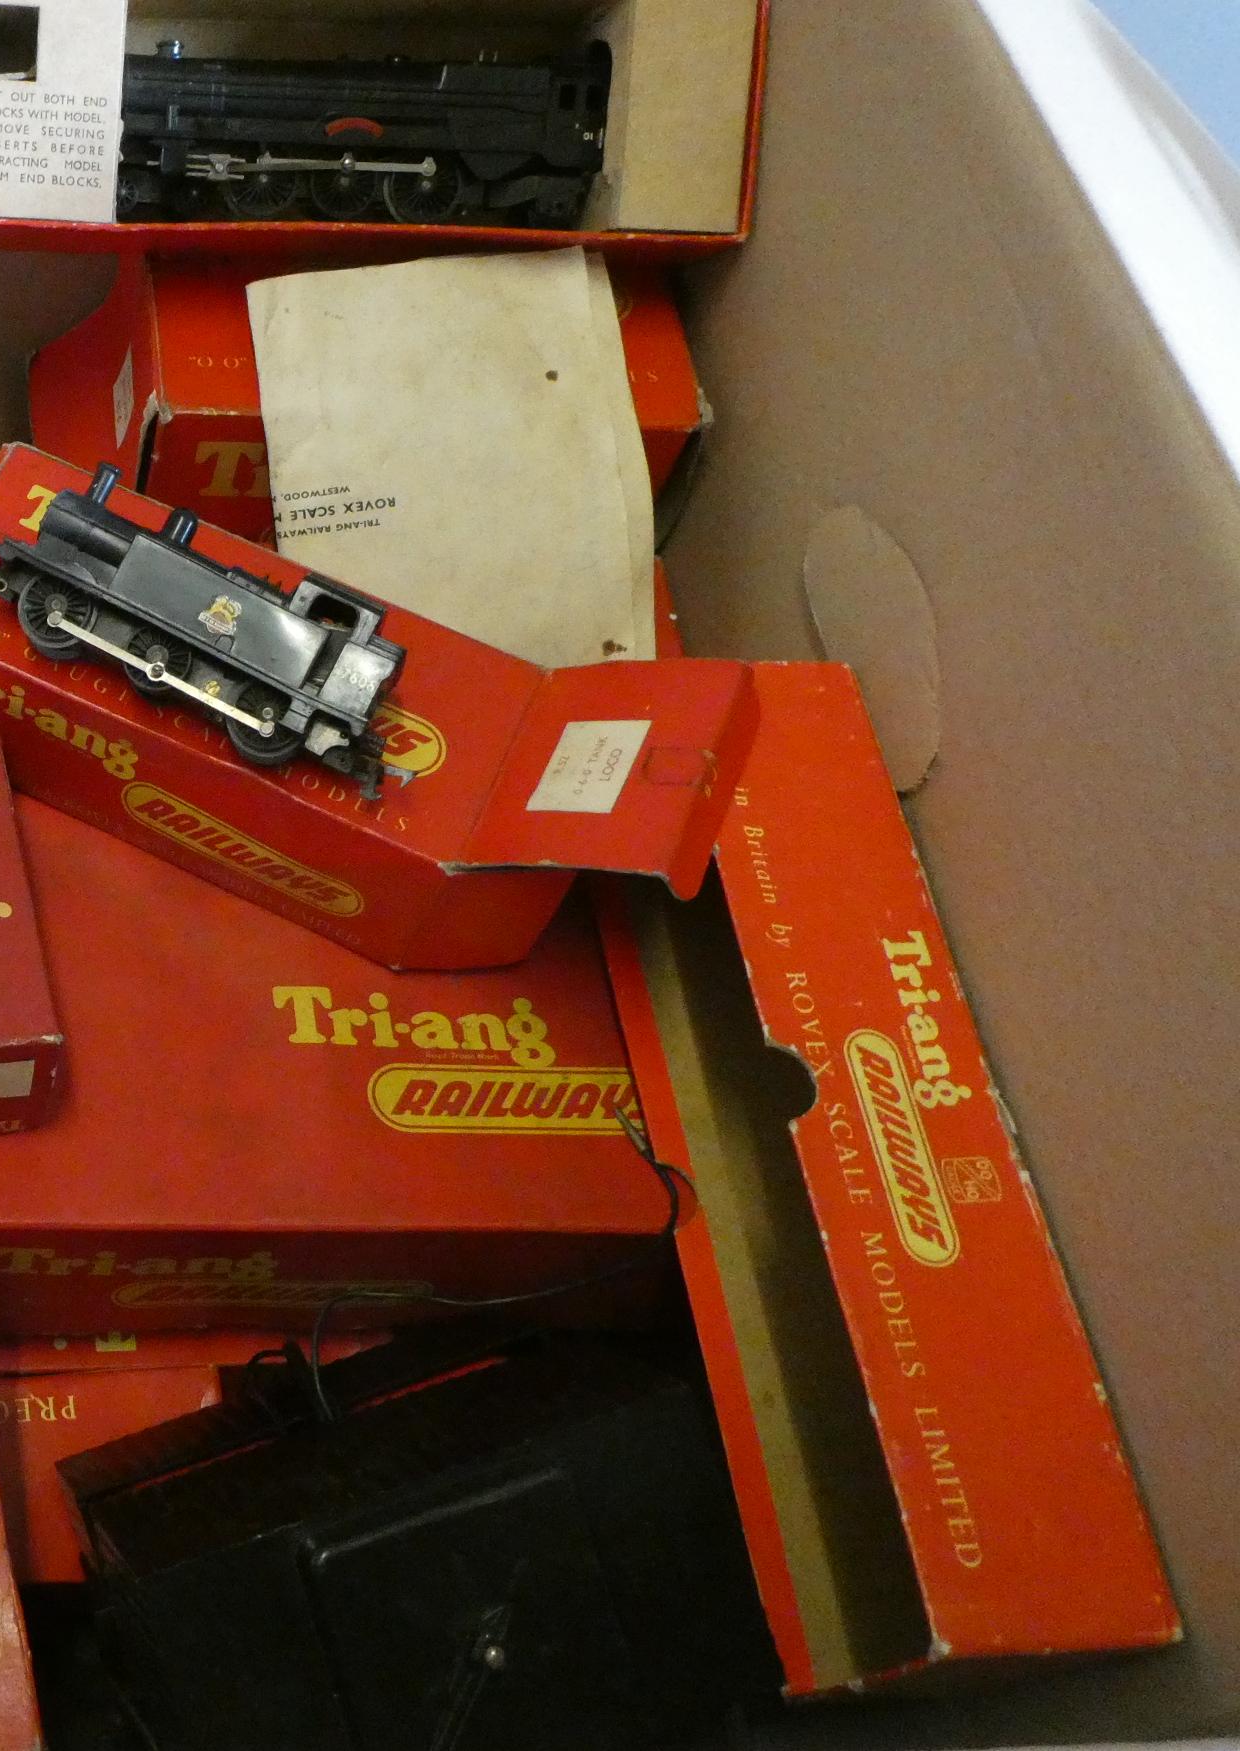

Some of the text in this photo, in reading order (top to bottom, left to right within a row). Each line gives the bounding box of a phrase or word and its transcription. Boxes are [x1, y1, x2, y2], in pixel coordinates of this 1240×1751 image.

[10, 91, 35, 103] OUT
[44, 93, 75, 105] BOTH
[83, 96, 108, 108] END
[28, 109, 58, 121] WITH
[41, 126, 105, 140] SECURING
[50, 142, 105, 156] BEFORE
[64, 159, 103, 172] MODEL
[20, 173, 45, 184] END
[290, 505, 336, 522] SCALE
[343, 496, 397, 514] ROVEX
[276, 518, 381, 540] TRI-ANG RAILWAYS
[599, 748, 623, 783] LOCO
[135, 797, 353, 903] RAILWAYS
[272, 985, 556, 1069] Tri-ang
[881, 930, 973, 1109] Tri-ang
[854, 1043, 949, 1252] RAILWAYS
[743, 825, 777, 904] Britain
[764, 922, 793, 948] by
[785, 971, 835, 1077] ROVEX
[823, 1102, 873, 1205] SCALE
[861, 1231, 927, 1379] MODELS
[914, 1406, 983, 1568] LIMITED
